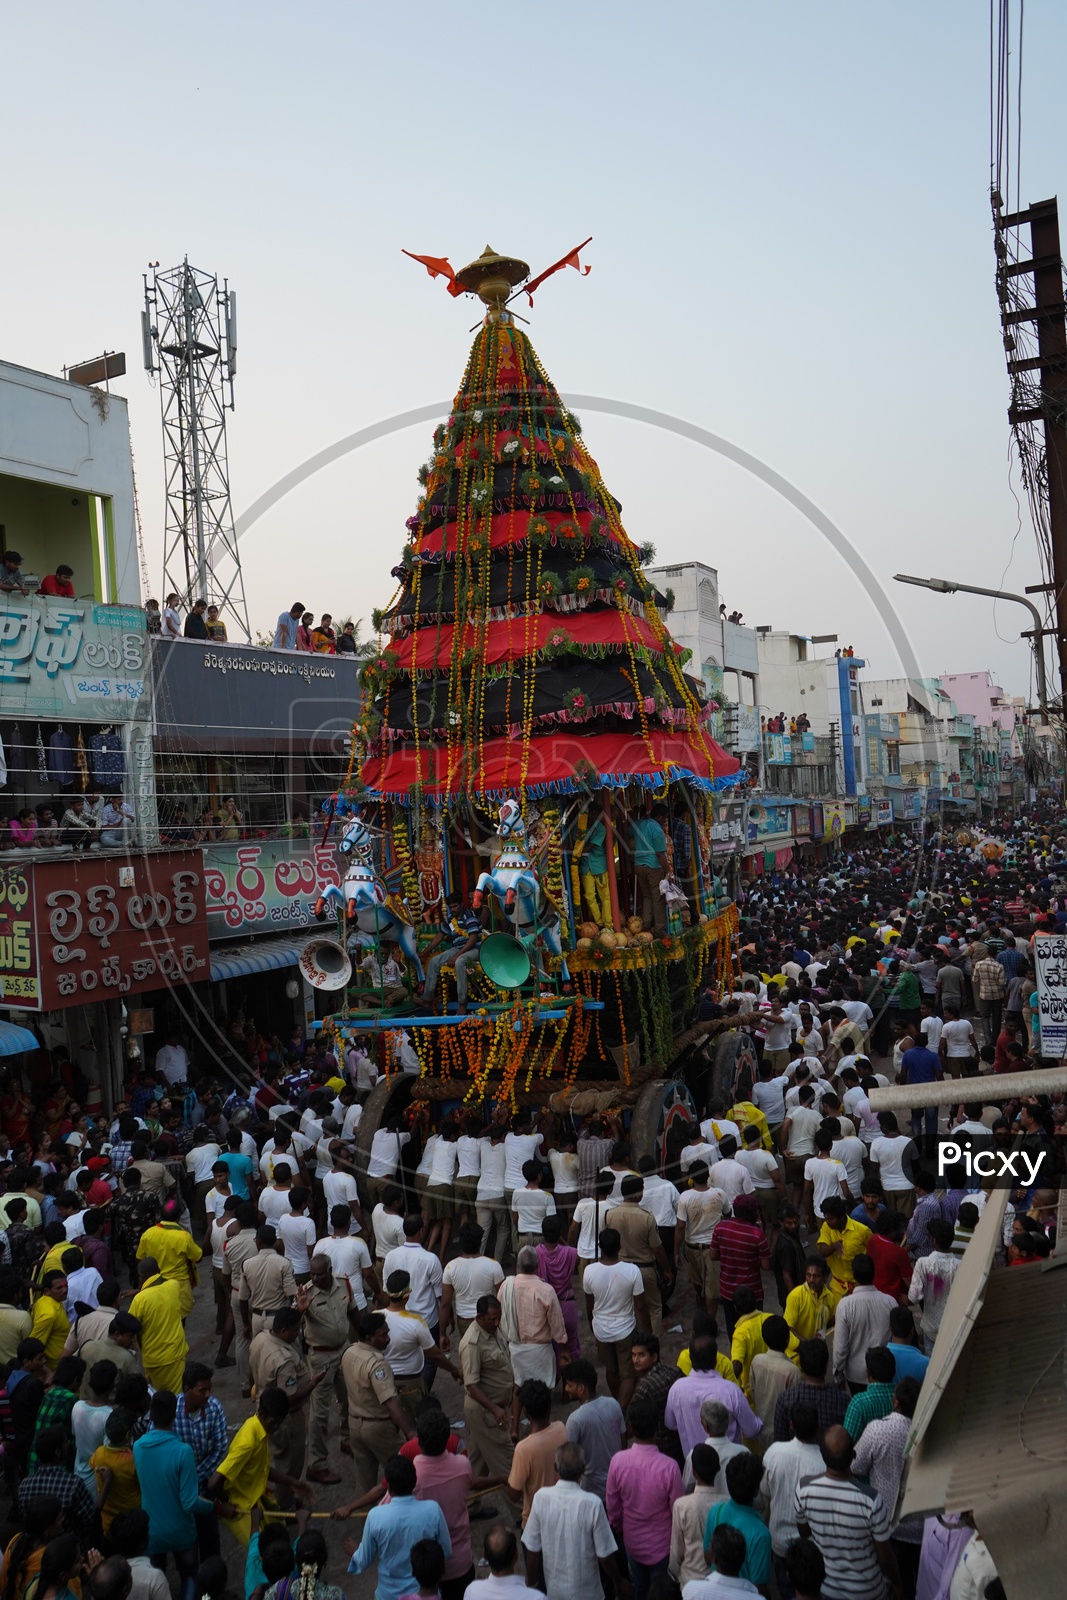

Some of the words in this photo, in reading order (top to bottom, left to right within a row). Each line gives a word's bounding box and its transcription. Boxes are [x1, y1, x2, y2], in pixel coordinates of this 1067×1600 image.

[83, 632, 145, 671] లుక్
[115, 681, 145, 699] కార్నర్
[275, 843, 340, 897] లుక్
[46, 885, 119, 964] లైఫ్
[127, 871, 199, 930] లుక్
[131, 945, 197, 981] కార్నర్
